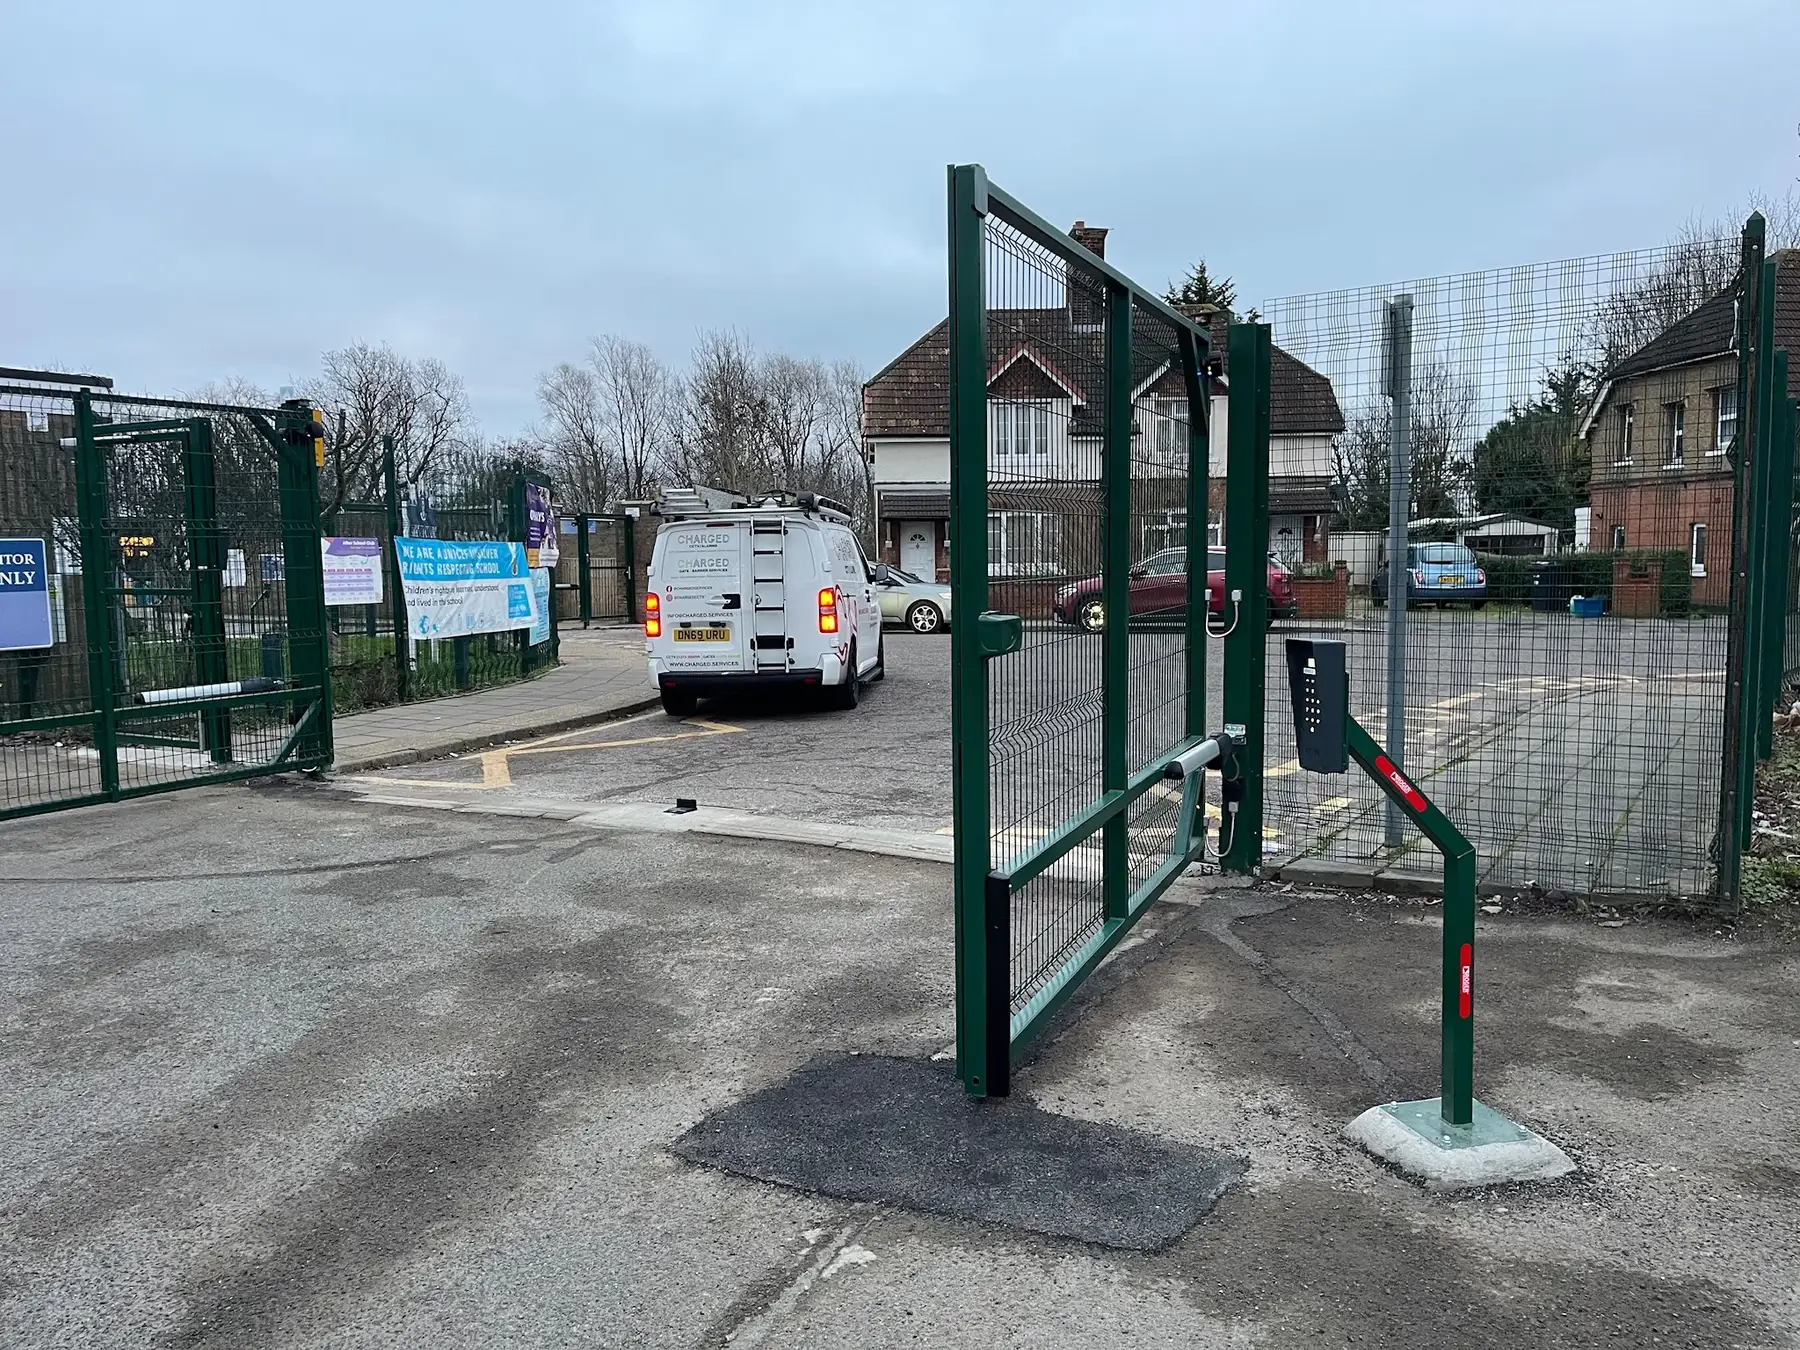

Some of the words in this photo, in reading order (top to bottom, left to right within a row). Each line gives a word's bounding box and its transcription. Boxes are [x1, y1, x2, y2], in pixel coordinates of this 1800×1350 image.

[677, 534, 730, 544] CHARGED
[402, 545, 415, 559] WE
[416, 547, 435, 560] ARE
[475, 562, 500, 574] SCHOOL
[677, 558, 730, 568] CHARGED
[446, 597, 463, 606] school
[677, 630, 704, 640] DN69
[705, 629, 726, 640] URU
[1393, 772, 1412, 794] ROGER
[1462, 973, 1470, 994] ROGER
